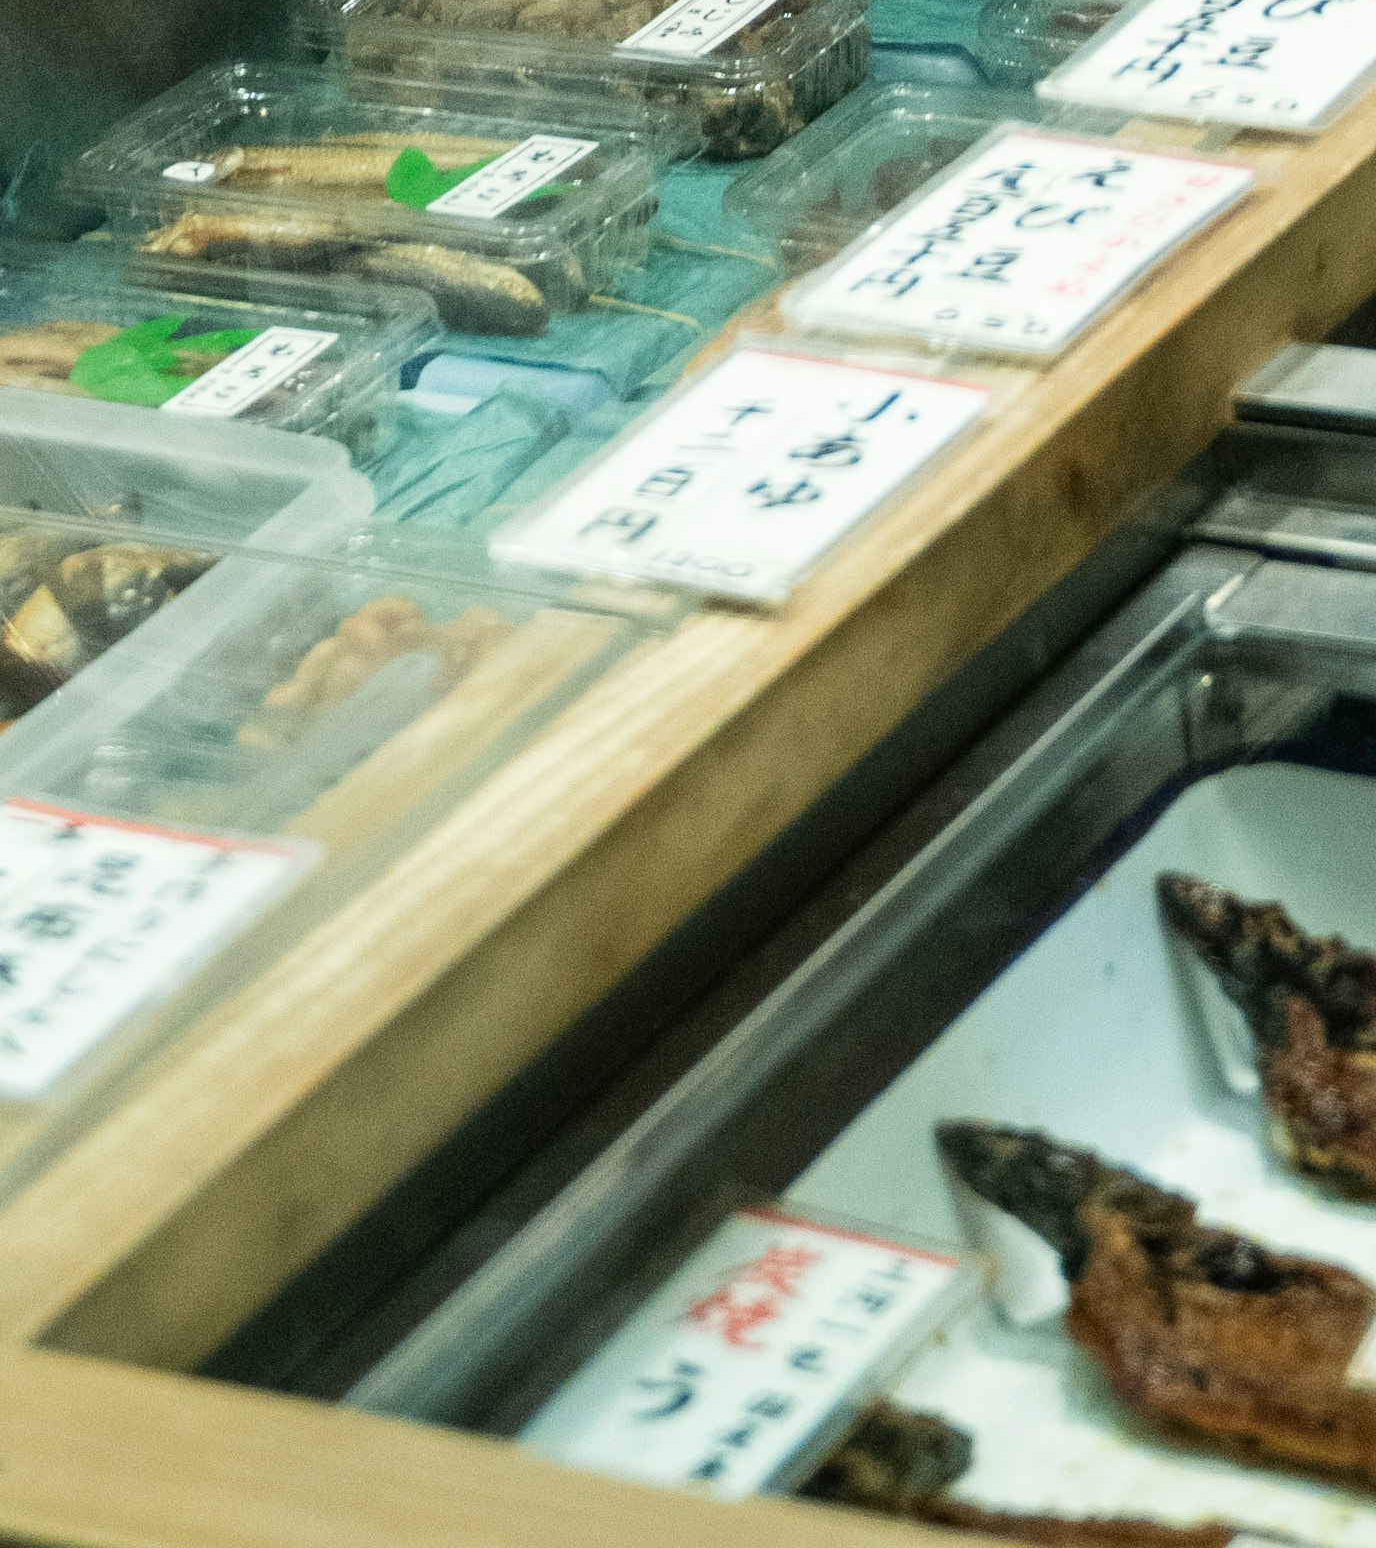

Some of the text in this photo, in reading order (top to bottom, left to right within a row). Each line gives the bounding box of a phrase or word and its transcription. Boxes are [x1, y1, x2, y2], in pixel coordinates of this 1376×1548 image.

[959, 158, 1133, 282] えび豆
[747, 390, 919, 508] 小あゆ
